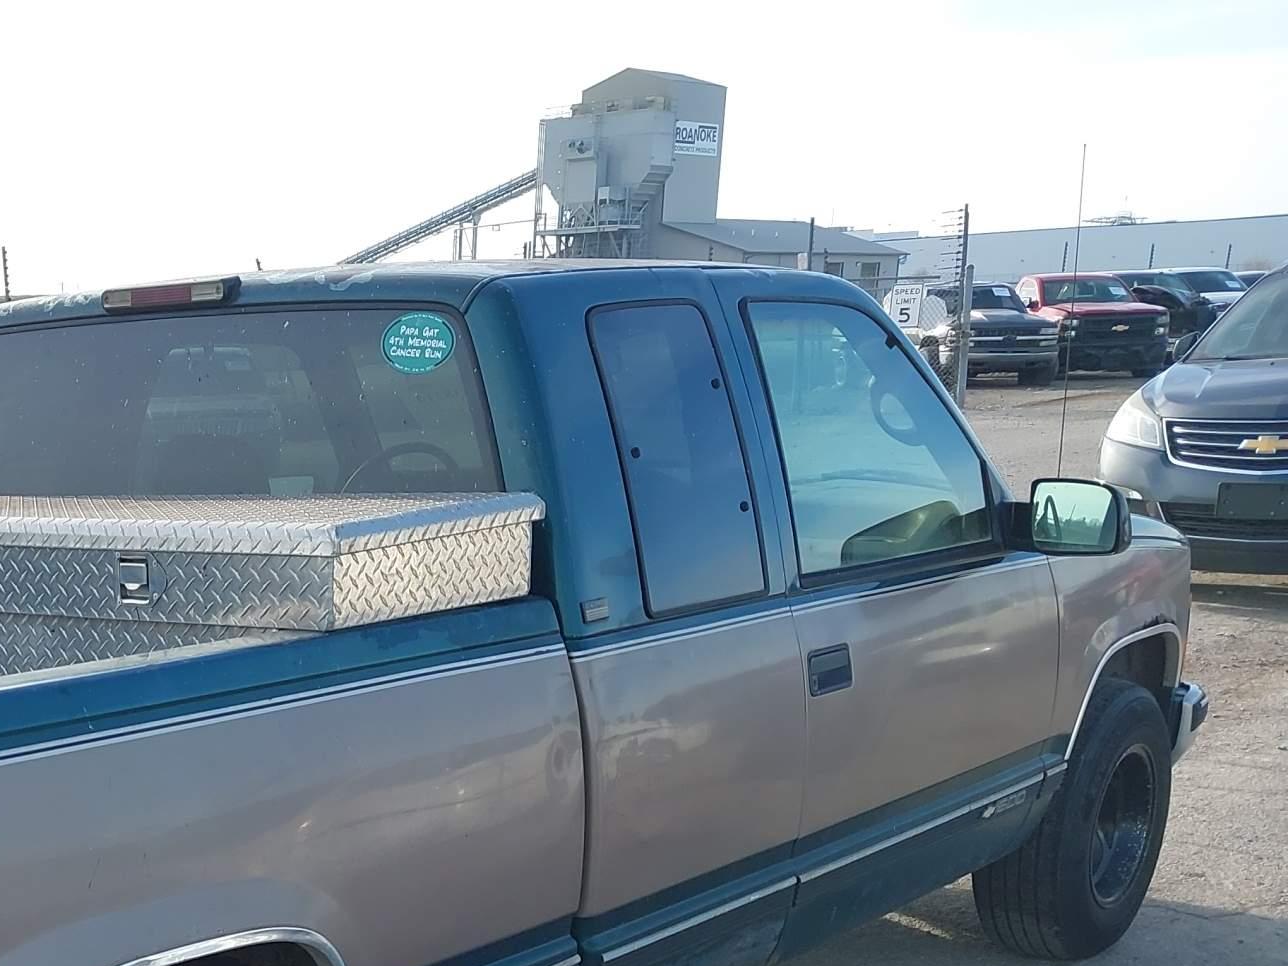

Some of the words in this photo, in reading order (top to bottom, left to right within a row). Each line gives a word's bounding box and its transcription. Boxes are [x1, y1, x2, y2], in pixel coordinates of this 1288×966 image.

[675, 127, 717, 142] ROANOKE
[898, 307, 910, 323] 5
[400, 325, 419, 336] PAPA
[389, 336, 404, 346] 4TH
[408, 337, 447, 348] MEMORIAL
[390, 346, 421, 357] CANCER
